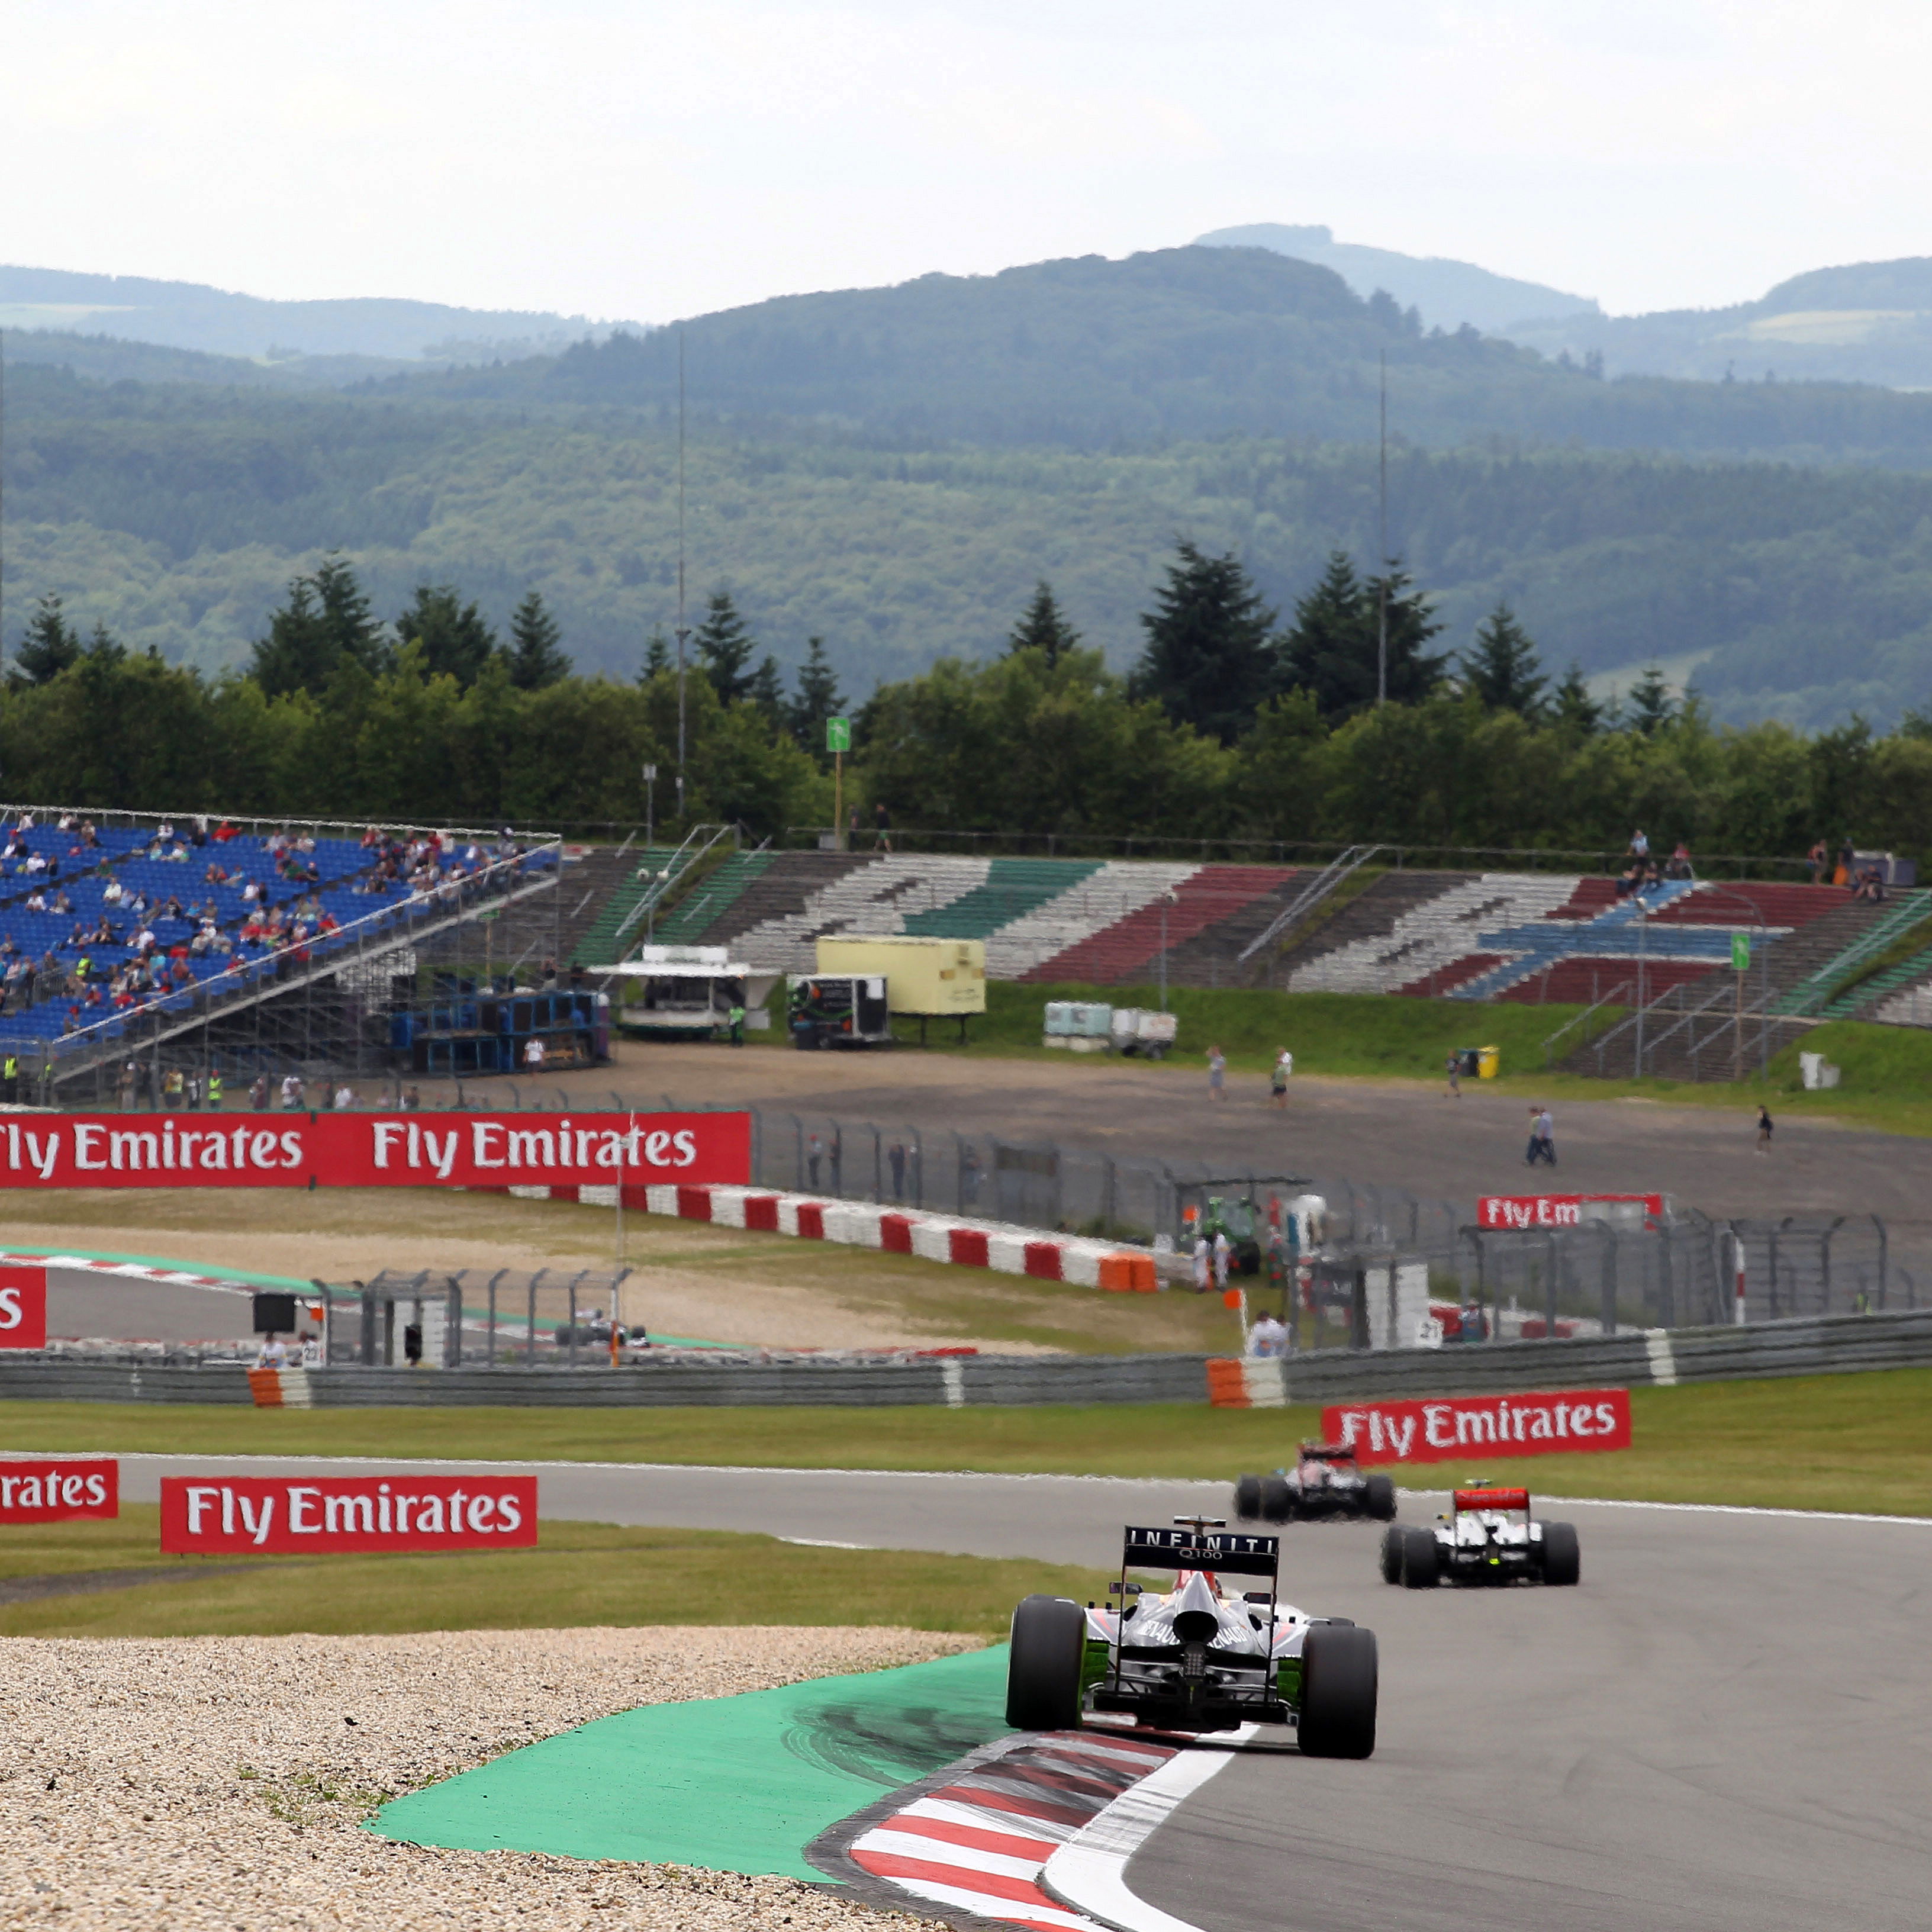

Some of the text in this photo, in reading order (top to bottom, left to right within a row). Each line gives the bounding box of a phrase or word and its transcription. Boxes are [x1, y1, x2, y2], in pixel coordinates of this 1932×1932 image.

[0, 1120, 303, 1179] ly Emirates
[372, 1119, 697, 1179] Fly Emirates
[1339, 1401, 1616, 1457] Fly Emirates
[186, 1483, 521, 1544] Fly Emirates
[1131, 1530, 1273, 1554] INFINITI
[1178, 1549, 1223, 1560] Q100
